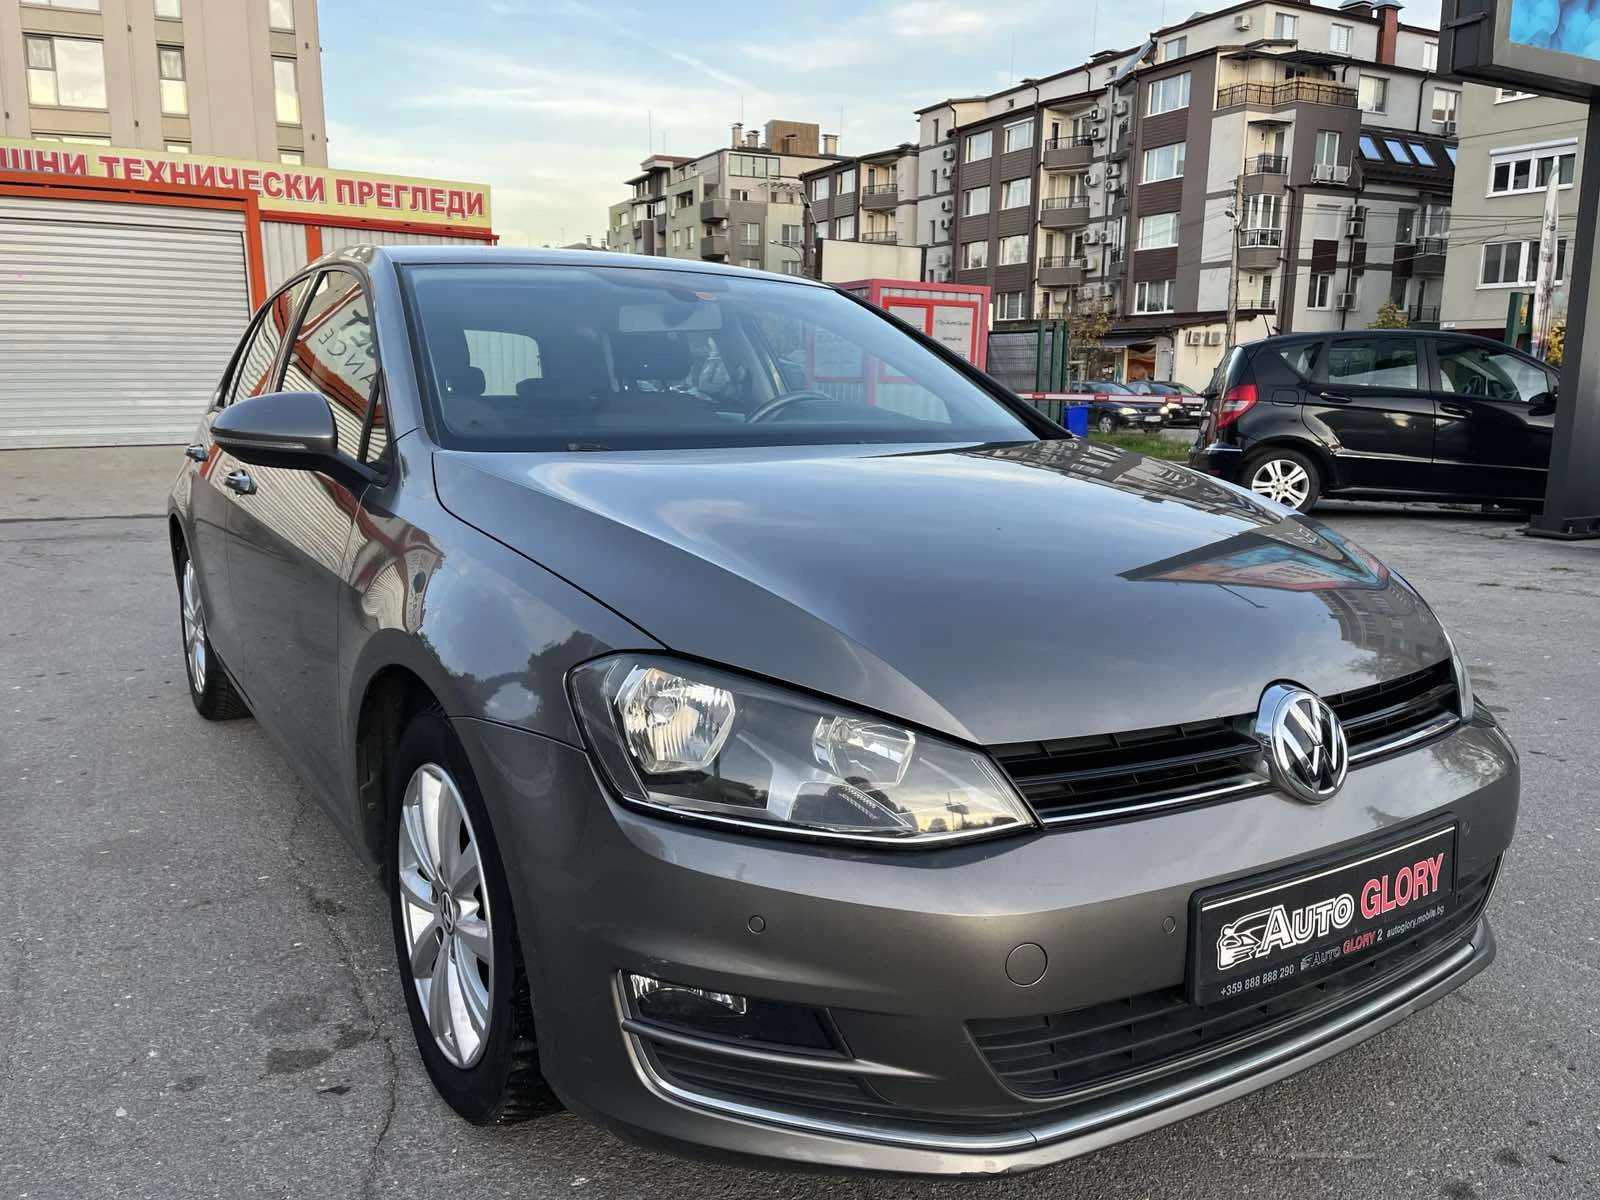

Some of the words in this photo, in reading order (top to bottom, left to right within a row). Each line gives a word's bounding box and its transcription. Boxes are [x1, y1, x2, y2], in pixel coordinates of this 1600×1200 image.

[98, 155, 327, 203] ТЕХНИЧЕСКИ
[335, 178, 485, 219] ПРЕГЛЕДИ
[1360, 852, 1444, 919] GLORY
[1221, 981, 1242, 996] +359
[1244, 975, 1260, 990] 888
[1262, 970, 1278, 985] 888
[1279, 964, 1295, 978] 290
[1343, 930, 1377, 954] GLORY
[1376, 928, 1384, 942] 2
[1386, 905, 1445, 938] autoglory.mobile.bg
